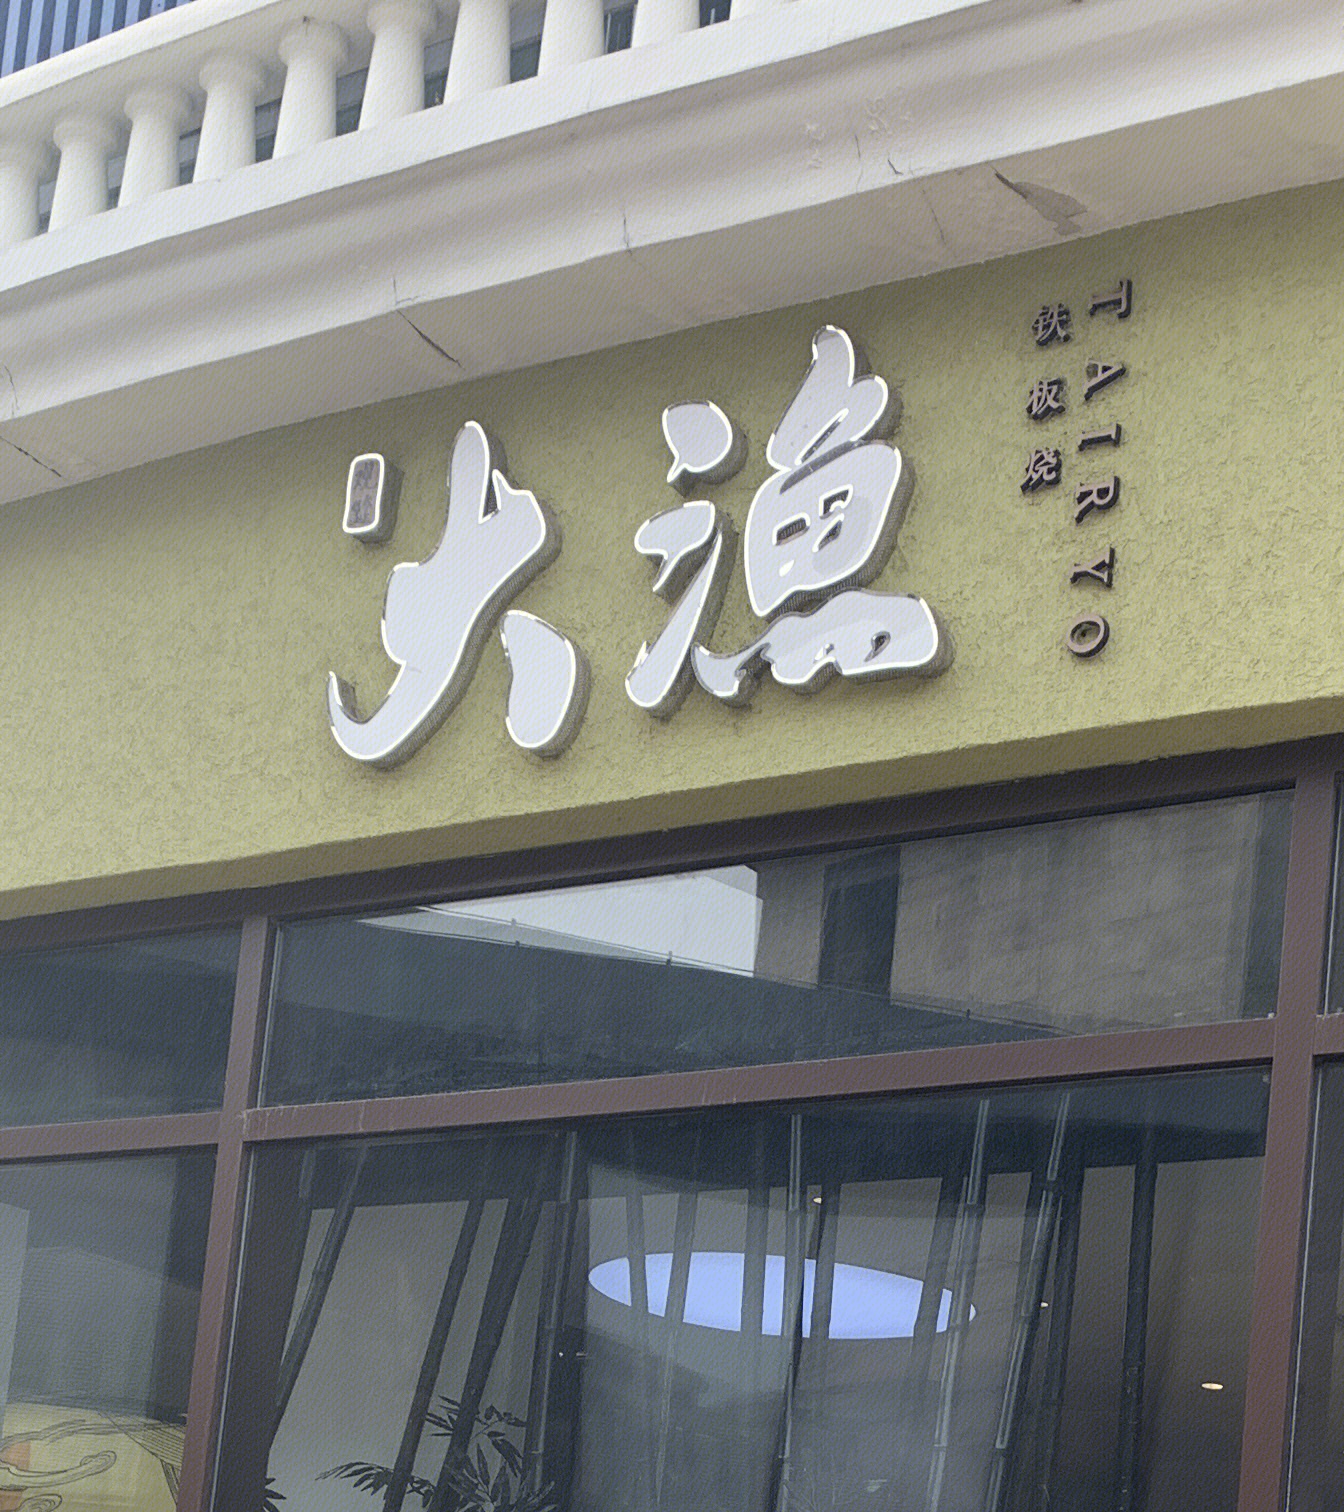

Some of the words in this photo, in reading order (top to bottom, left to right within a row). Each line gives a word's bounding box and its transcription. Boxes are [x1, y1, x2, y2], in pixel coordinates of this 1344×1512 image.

[1021, 303, 1072, 494] 铁板烧
[1066, 278, 1132, 658] TAIRYO
